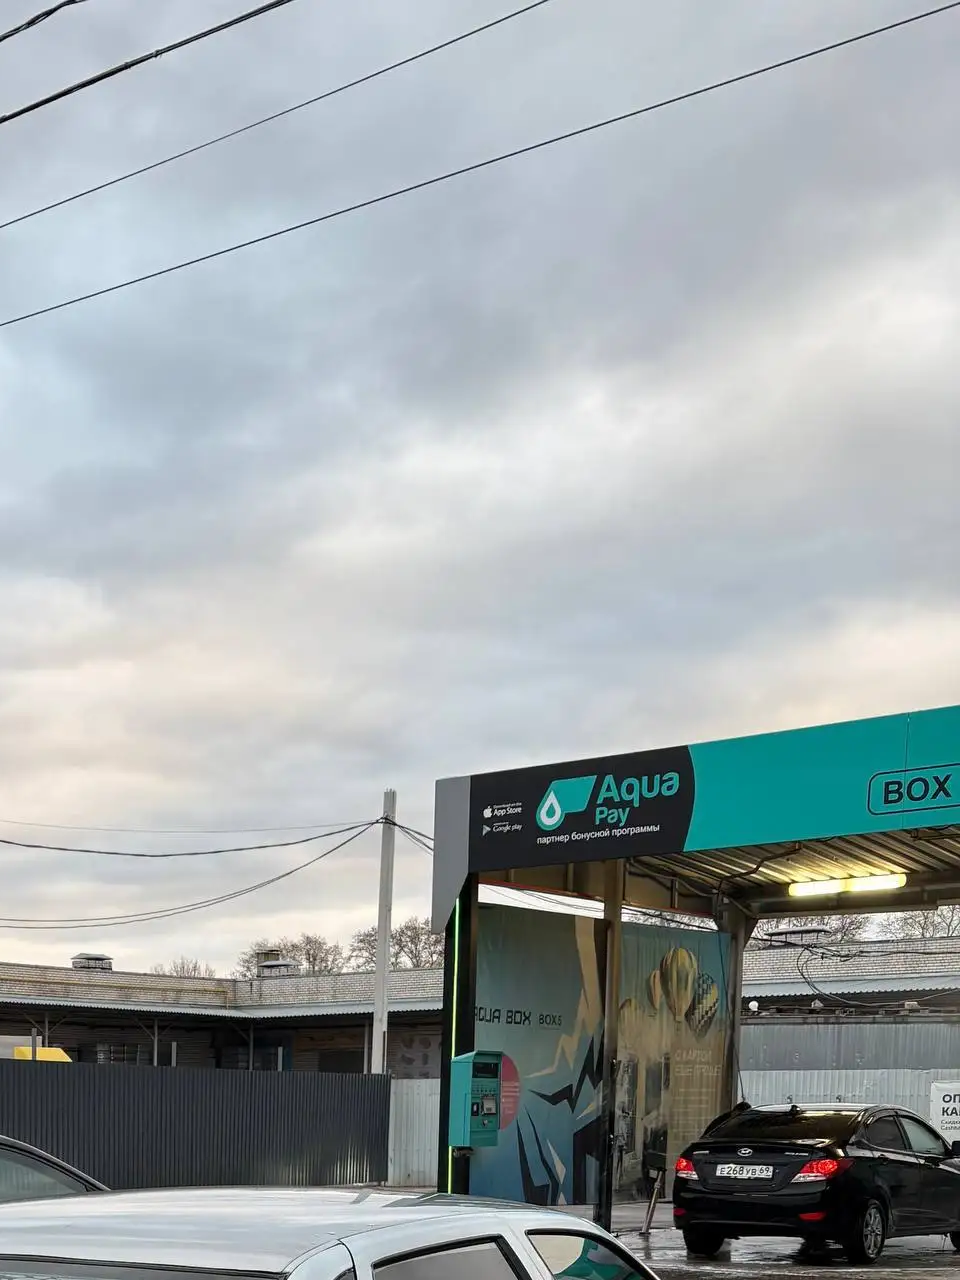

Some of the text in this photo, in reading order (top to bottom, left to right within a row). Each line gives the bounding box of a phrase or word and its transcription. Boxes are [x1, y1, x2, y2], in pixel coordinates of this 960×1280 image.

[596, 772, 680, 808] Aqua
[883, 773, 952, 805] BOX
[493, 806, 522, 816] App Store
[594, 807, 631, 827] Pay
[536, 824, 660, 845] партнер бонусной программы
[505, 1009, 531, 1026] BOX
[941, 1106, 960, 1117] КА
